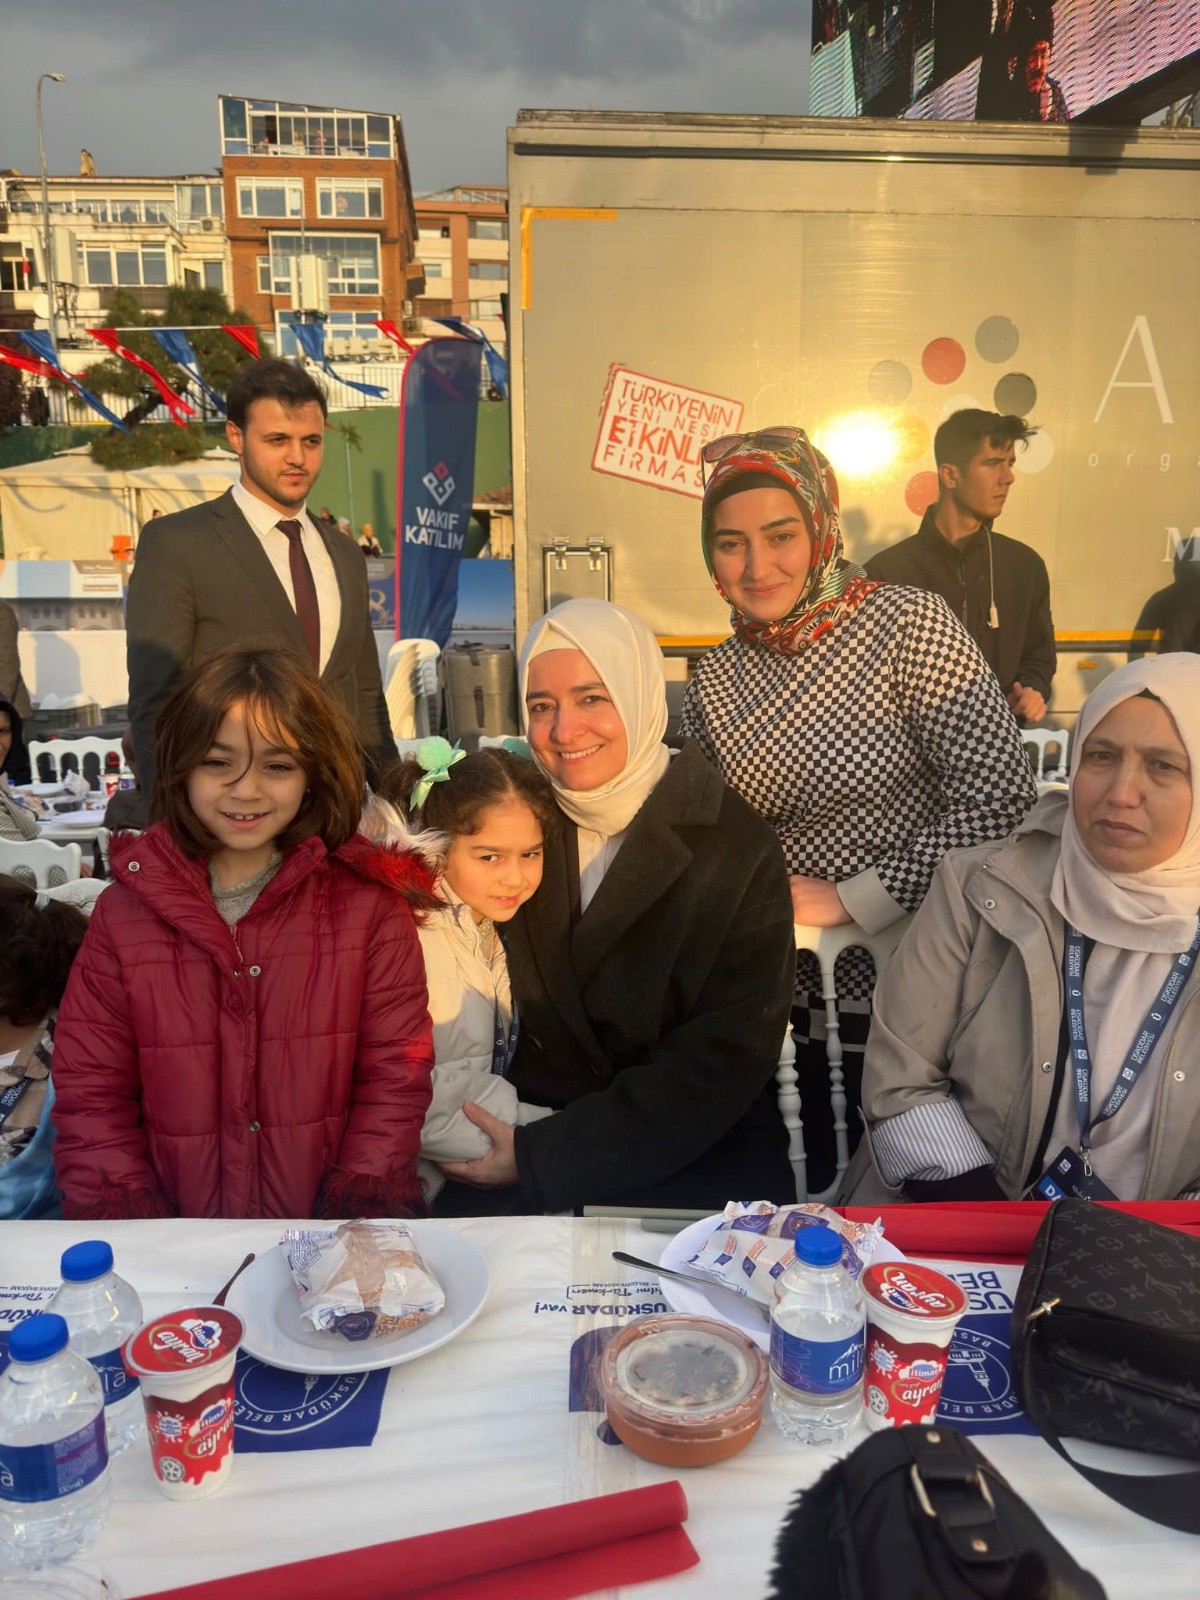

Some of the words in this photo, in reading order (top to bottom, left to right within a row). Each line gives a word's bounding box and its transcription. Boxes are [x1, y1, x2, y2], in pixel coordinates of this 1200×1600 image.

[617, 400, 662, 424] YENİ
[608, 415, 711, 467] ETKİNLİ
[603, 444, 704, 488] FİRMAS
[1088, 452, 1200, 472] org
[416, 506, 460, 530] VAKIF
[405, 525, 465, 551] KATILIM
[534, 1302, 567, 1314] var!
[153, 1331, 205, 1363] ayran
[282, 1376, 358, 1422] ÜSKÜDAR
[940, 1401, 974, 1414] BEL
